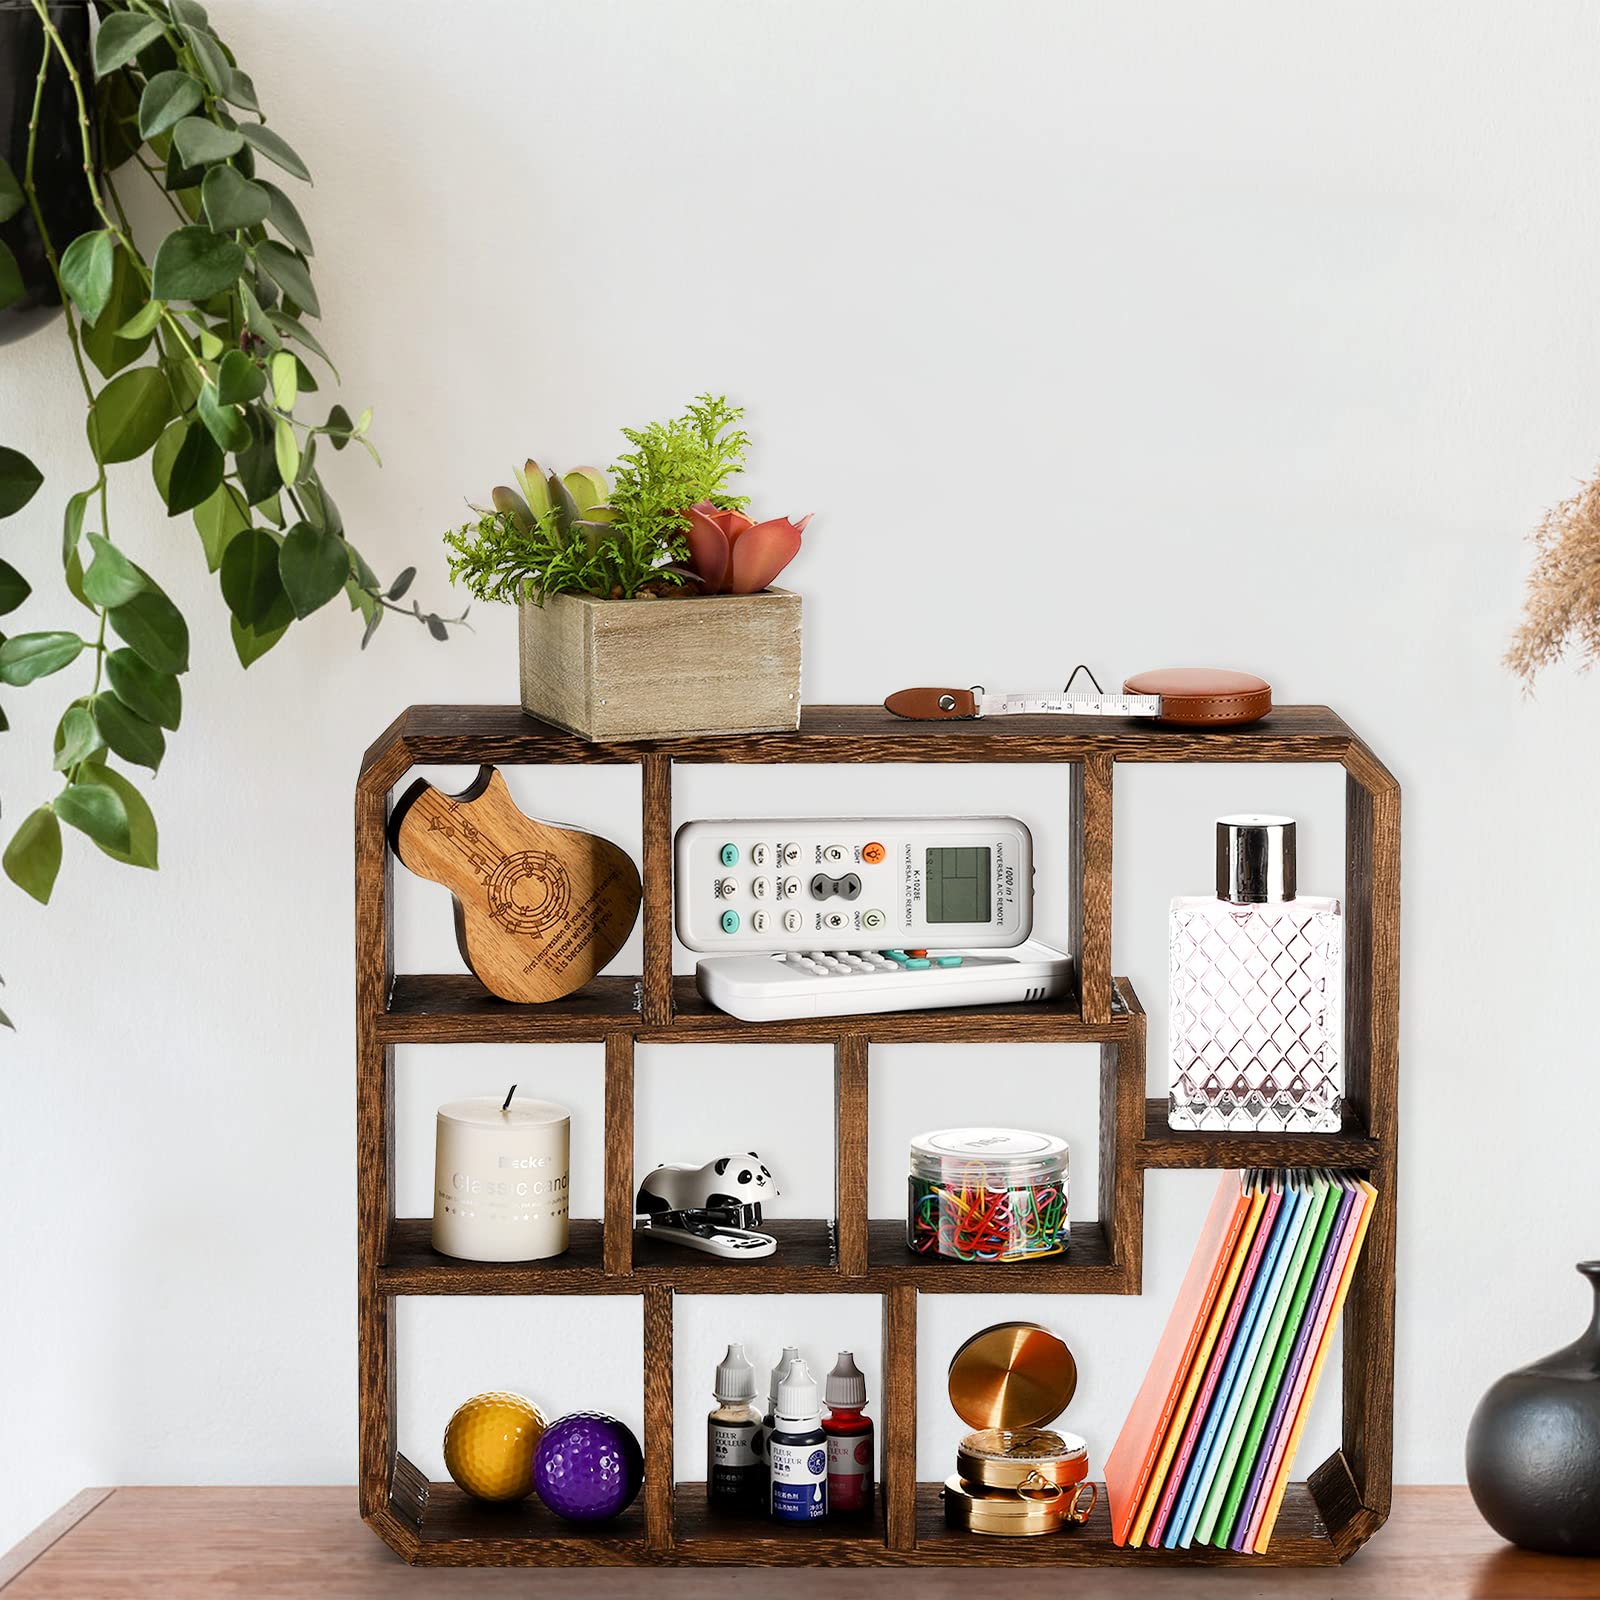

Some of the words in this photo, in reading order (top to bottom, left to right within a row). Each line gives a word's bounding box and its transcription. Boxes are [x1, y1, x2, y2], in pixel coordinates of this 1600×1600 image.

[1006, 887, 1013, 895] in
[544, 959, 554, 969] If
[553, 937, 573, 959] know
[570, 919, 590, 940] what
[586, 903, 604, 922] love
[523, 959, 539, 975] First
[534, 928, 567, 963] impression
[562, 920, 573, 931] of
[569, 911, 583, 926] you
[553, 965, 563, 975] it
[559, 959, 568, 969] is
[565, 931, 594, 962] because
[590, 923, 601, 934] of
[598, 910, 615, 928] you
[453, 1172, 528, 1196] Classc
[715, 1431, 736, 1439] FLEUR
[773, 1448, 792, 1456] FLEUR
[773, 1455, 802, 1465] COULEUR
[810, 1508, 824, 1518] 10ml
